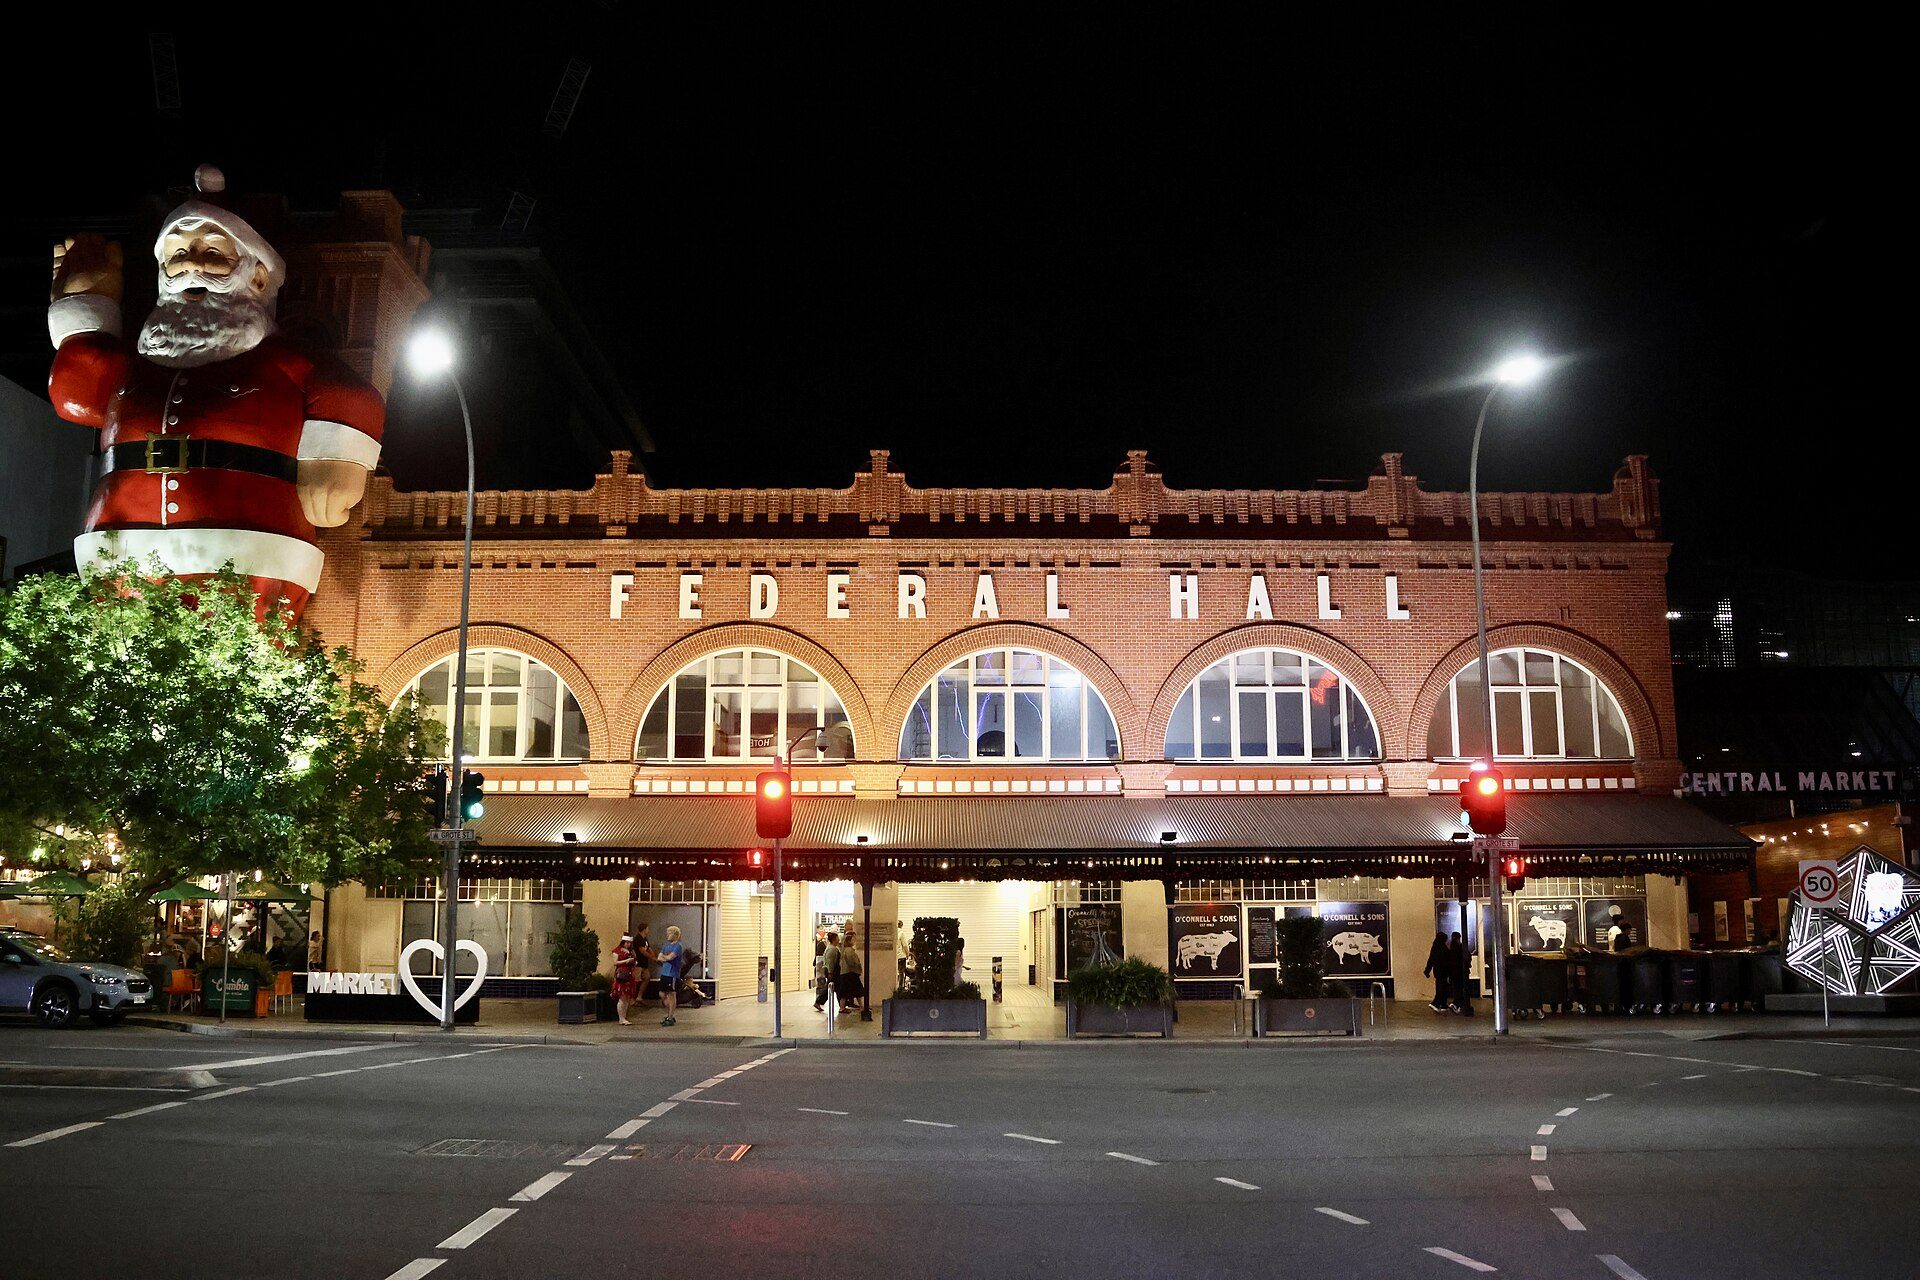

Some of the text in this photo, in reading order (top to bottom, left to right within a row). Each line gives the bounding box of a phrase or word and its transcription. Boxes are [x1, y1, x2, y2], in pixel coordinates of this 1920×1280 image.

[609, 574, 1410, 620] FEDERAL HALL
[1679, 771, 1897, 792] CENTRAL MARKET
[1807, 876, 1832, 892] 50
[1367, 913, 1385, 921] SONS
[211, 977, 250, 992] Cumbia
[307, 972, 400, 995] MARKET
